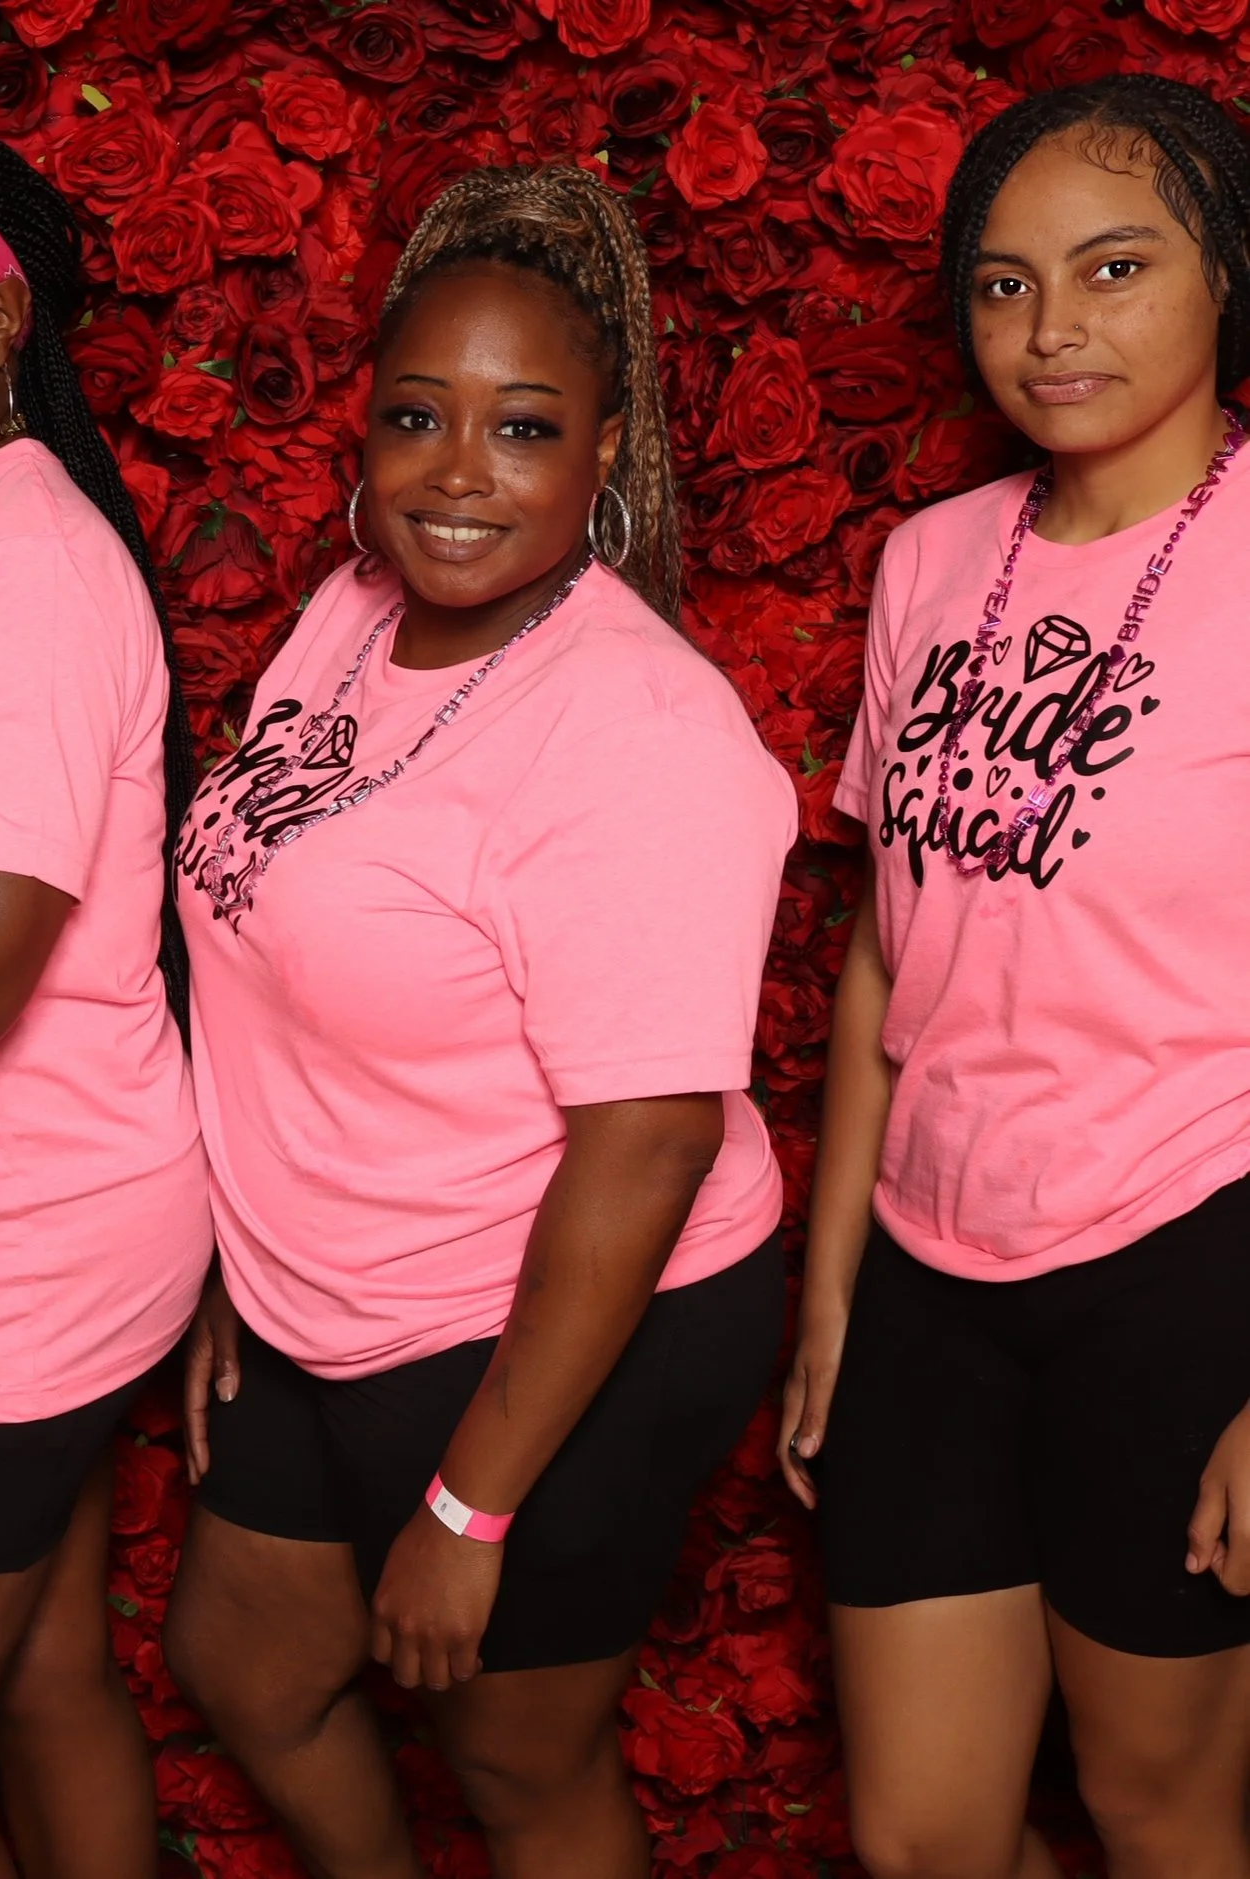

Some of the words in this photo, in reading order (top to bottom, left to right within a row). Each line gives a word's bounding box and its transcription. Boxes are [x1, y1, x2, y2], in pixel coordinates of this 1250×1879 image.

[1117, 553, 1173, 642] BRIDE
[897, 640, 1135, 780] Bride
[878, 761, 1075, 890] Squad
